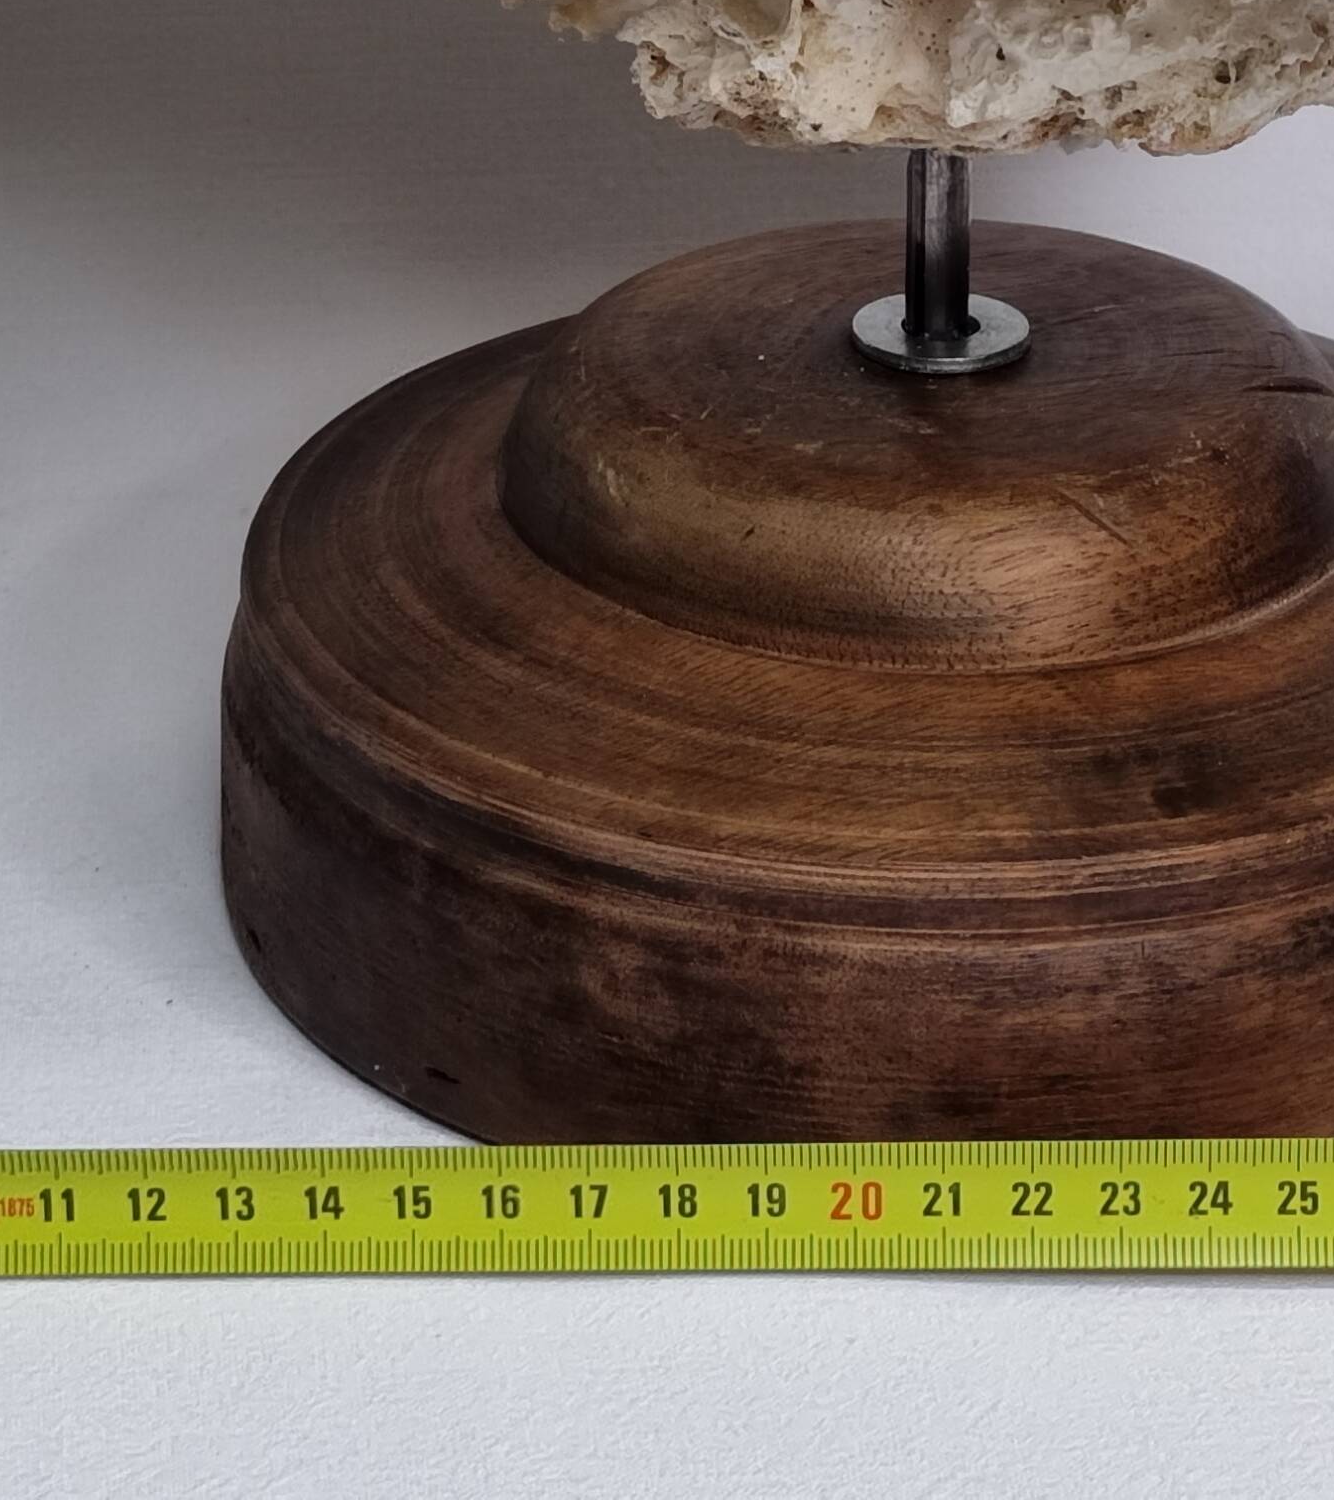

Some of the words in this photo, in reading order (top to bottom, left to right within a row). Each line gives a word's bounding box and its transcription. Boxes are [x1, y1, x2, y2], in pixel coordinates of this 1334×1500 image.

[39, 1187, 75, 1223] 11
[127, 1187, 167, 1222] 12
[215, 1186, 255, 1221] 13
[304, 1186, 345, 1220] 14
[393, 1185, 432, 1220] 15
[481, 1184, 520, 1219] 16
[570, 1184, 608, 1219] 17
[658, 1183, 697, 1218] 18
[747, 1182, 786, 1218] 19
[829, 1180, 884, 1221] 20
[922, 1182, 961, 1217] 21
[1011, 1181, 1053, 1216] 22
[1100, 1181, 1141, 1216] 23
[1188, 1180, 1233, 1216] 24
[1277, 1180, 1319, 1216] 25
